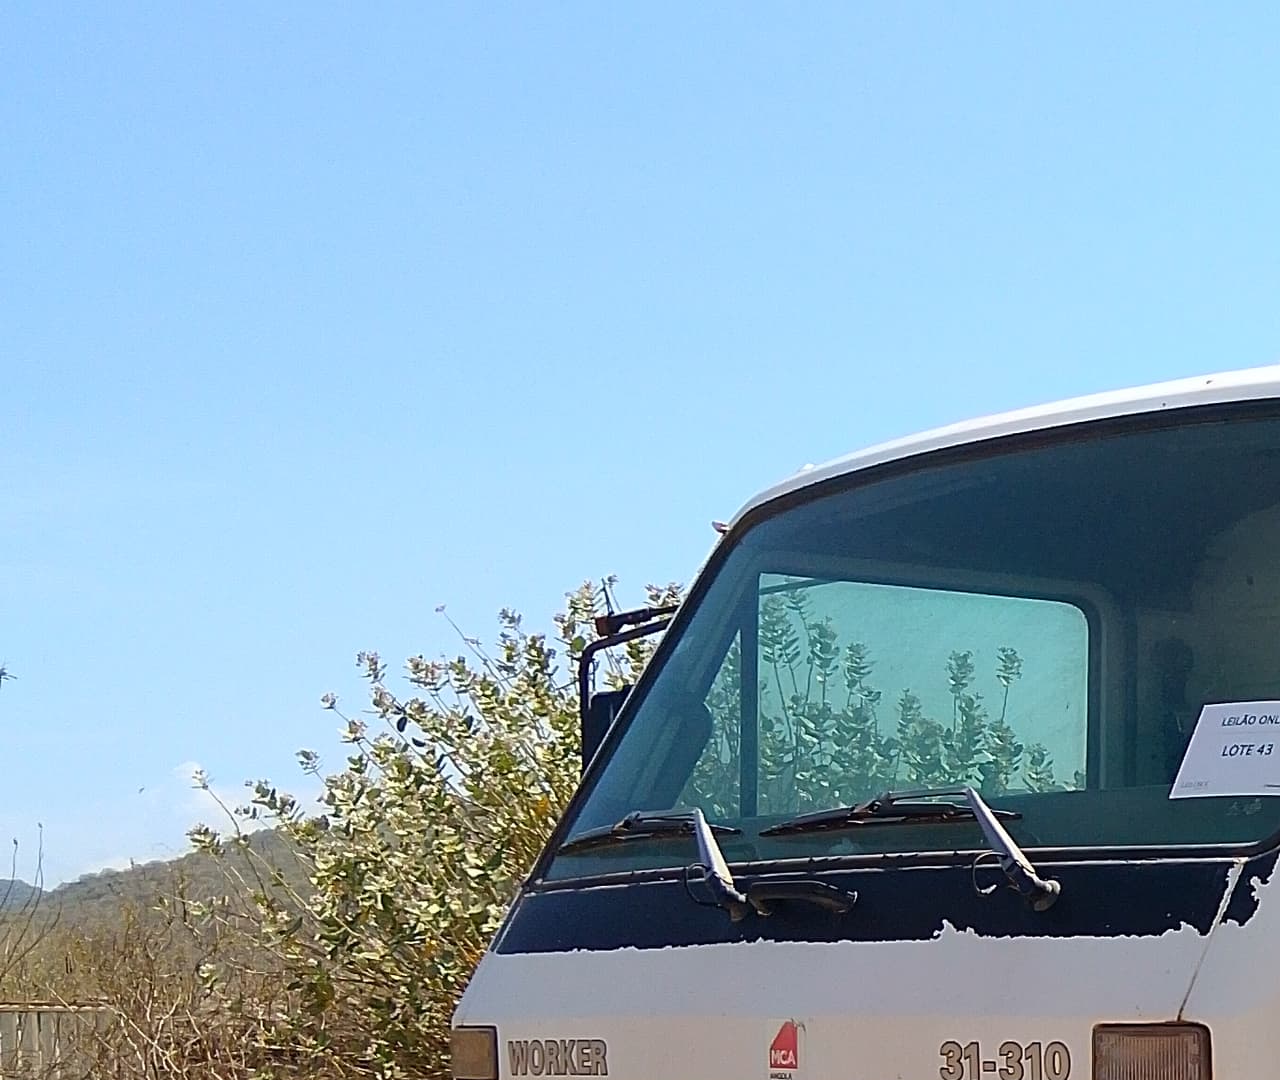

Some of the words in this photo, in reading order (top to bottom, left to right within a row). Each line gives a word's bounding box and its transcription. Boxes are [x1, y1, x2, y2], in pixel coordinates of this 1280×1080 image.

[1221, 714, 1257, 727] LEILÃO
[1221, 744, 1254, 757] LOTE
[1256, 743, 1274, 756] 43
[508, 1039, 609, 1077] WORKER
[771, 1049, 796, 1065] MCA
